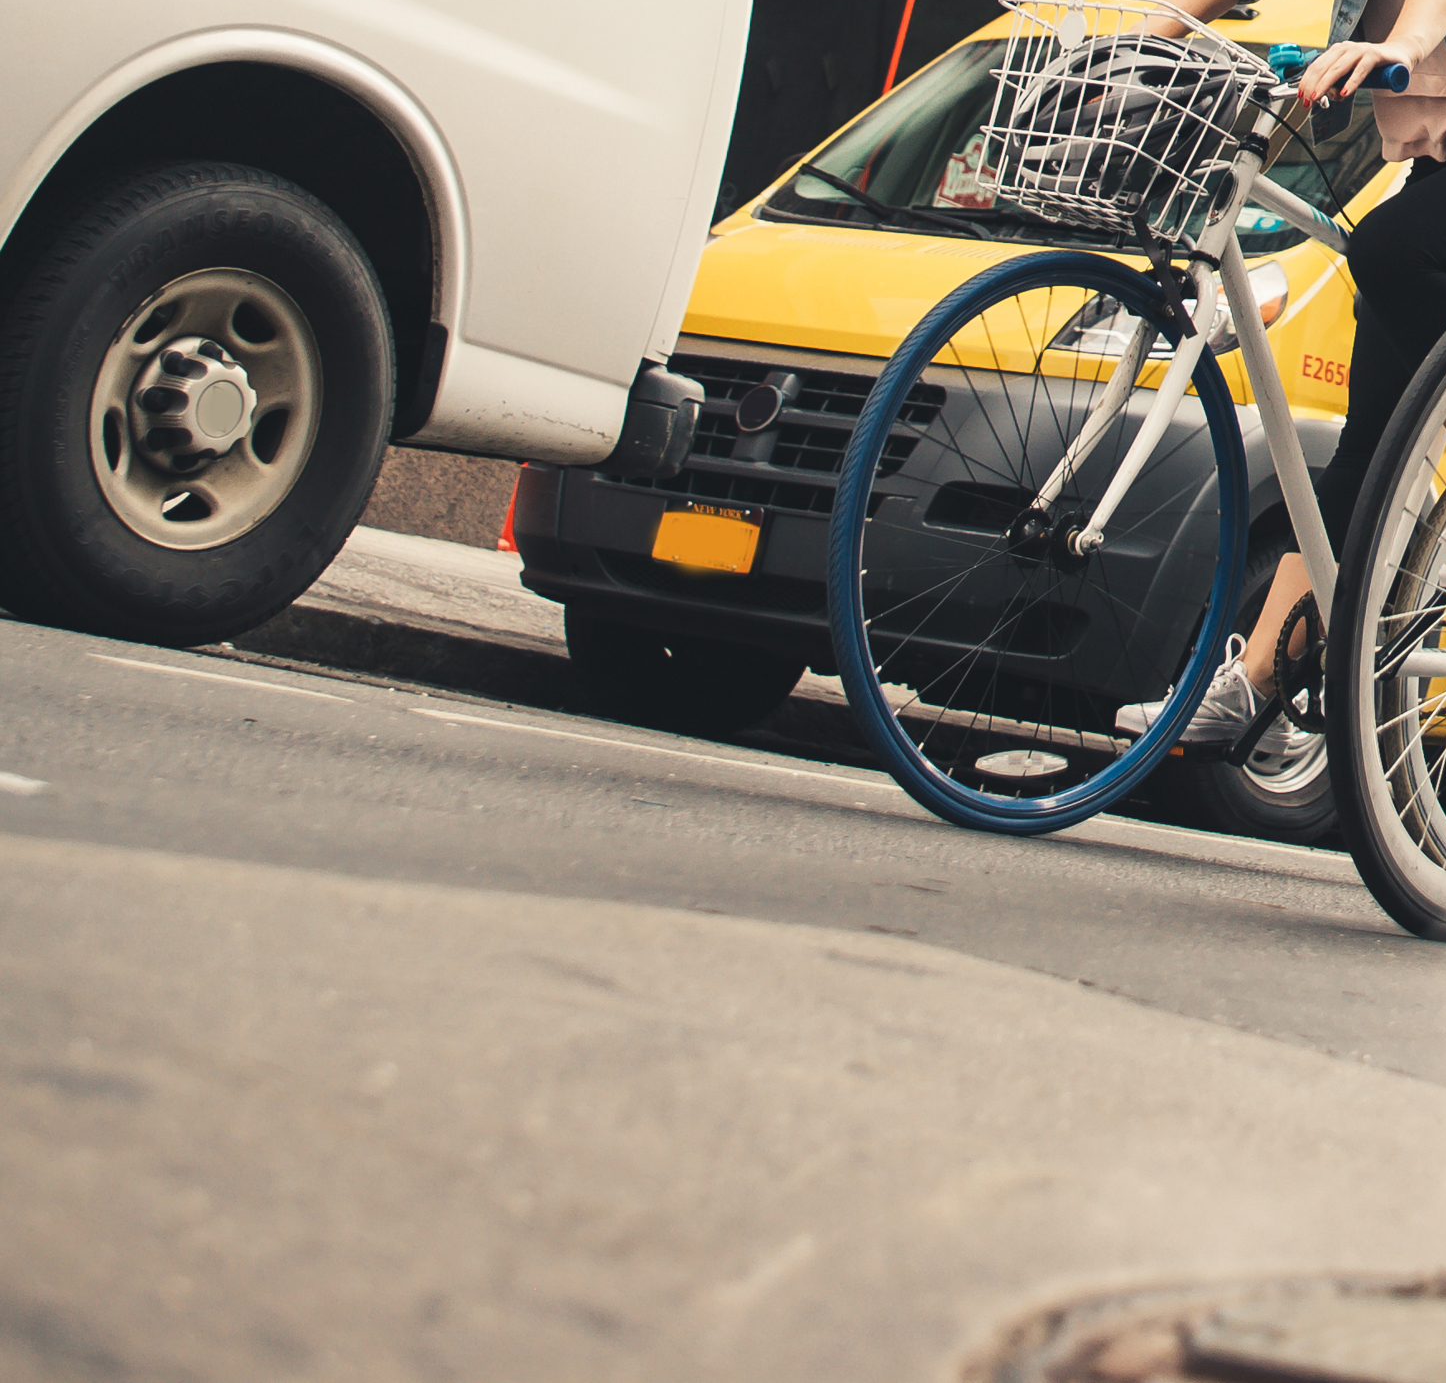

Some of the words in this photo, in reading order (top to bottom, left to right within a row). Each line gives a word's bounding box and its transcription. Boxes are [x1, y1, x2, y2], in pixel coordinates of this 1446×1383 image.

[107, 207, 336, 295] TRANSFORCE
[1302, 353, 1350, 389] E265
[693, 503, 717, 515] NEW
[719, 507, 743, 520] YORK
